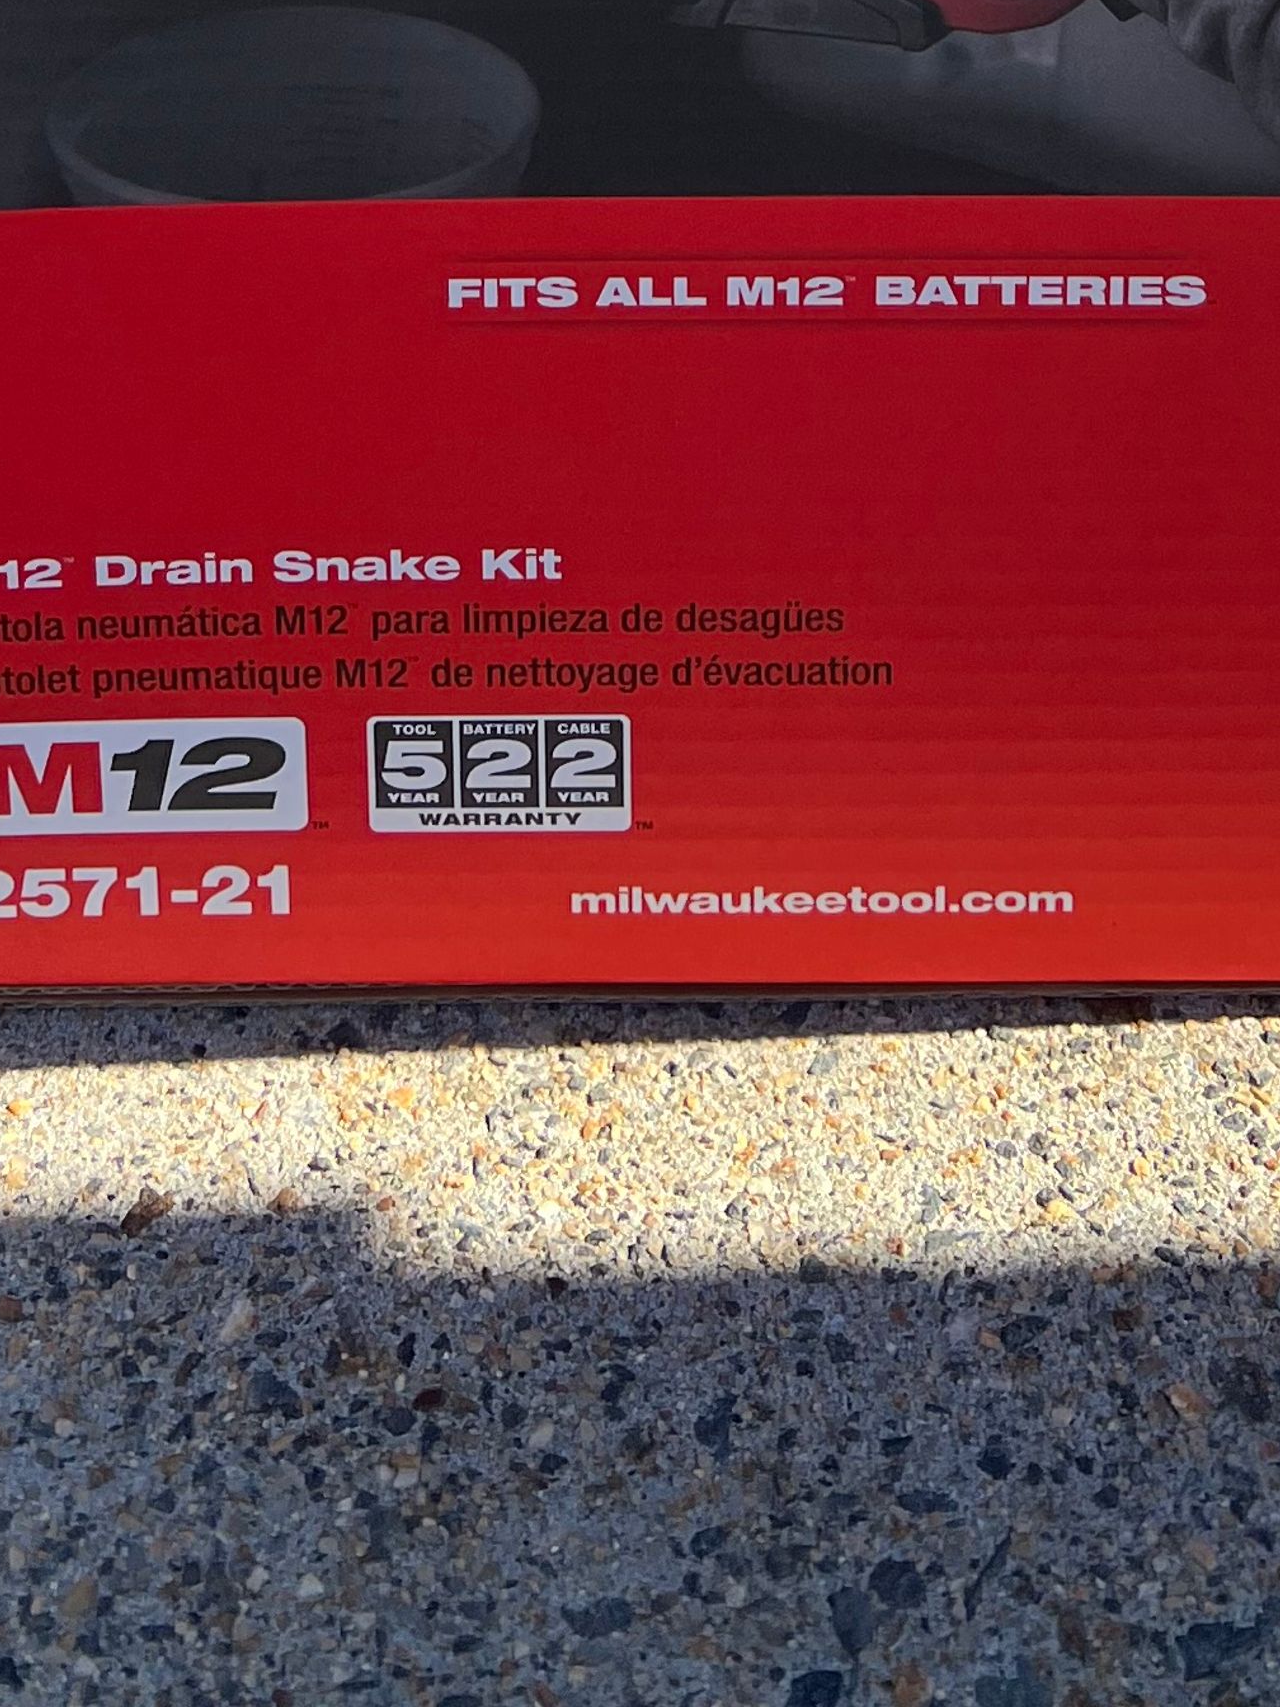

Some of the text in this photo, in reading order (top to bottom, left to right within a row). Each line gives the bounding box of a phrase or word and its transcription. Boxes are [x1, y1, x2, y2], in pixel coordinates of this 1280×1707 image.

[447, 277, 579, 308] FITS
[594, 276, 707, 307] ALL
[875, 274, 1207, 307] BATTERIES
[94, 552, 254, 587] Drain
[273, 549, 461, 583] Snake
[482, 548, 563, 581] Kit
[77, 605, 261, 641] neumática
[371, 610, 450, 641] para
[463, 602, 610, 639] limpieza
[621, 603, 664, 633] de
[676, 600, 844, 639] desagües
[92, 659, 321, 699] pneumatique
[431, 657, 474, 687] de
[486, 660, 659, 694] nettoyage
[393, 723, 611, 735] TOOL BATTERY CABLE
[381, 738, 617, 790] 5 2 2
[388, 792, 610, 804] YEAR YEAR YEAR
[419, 812, 582, 826] WARRANTY
[571, 886, 1073, 914] milwaukeetool.com
